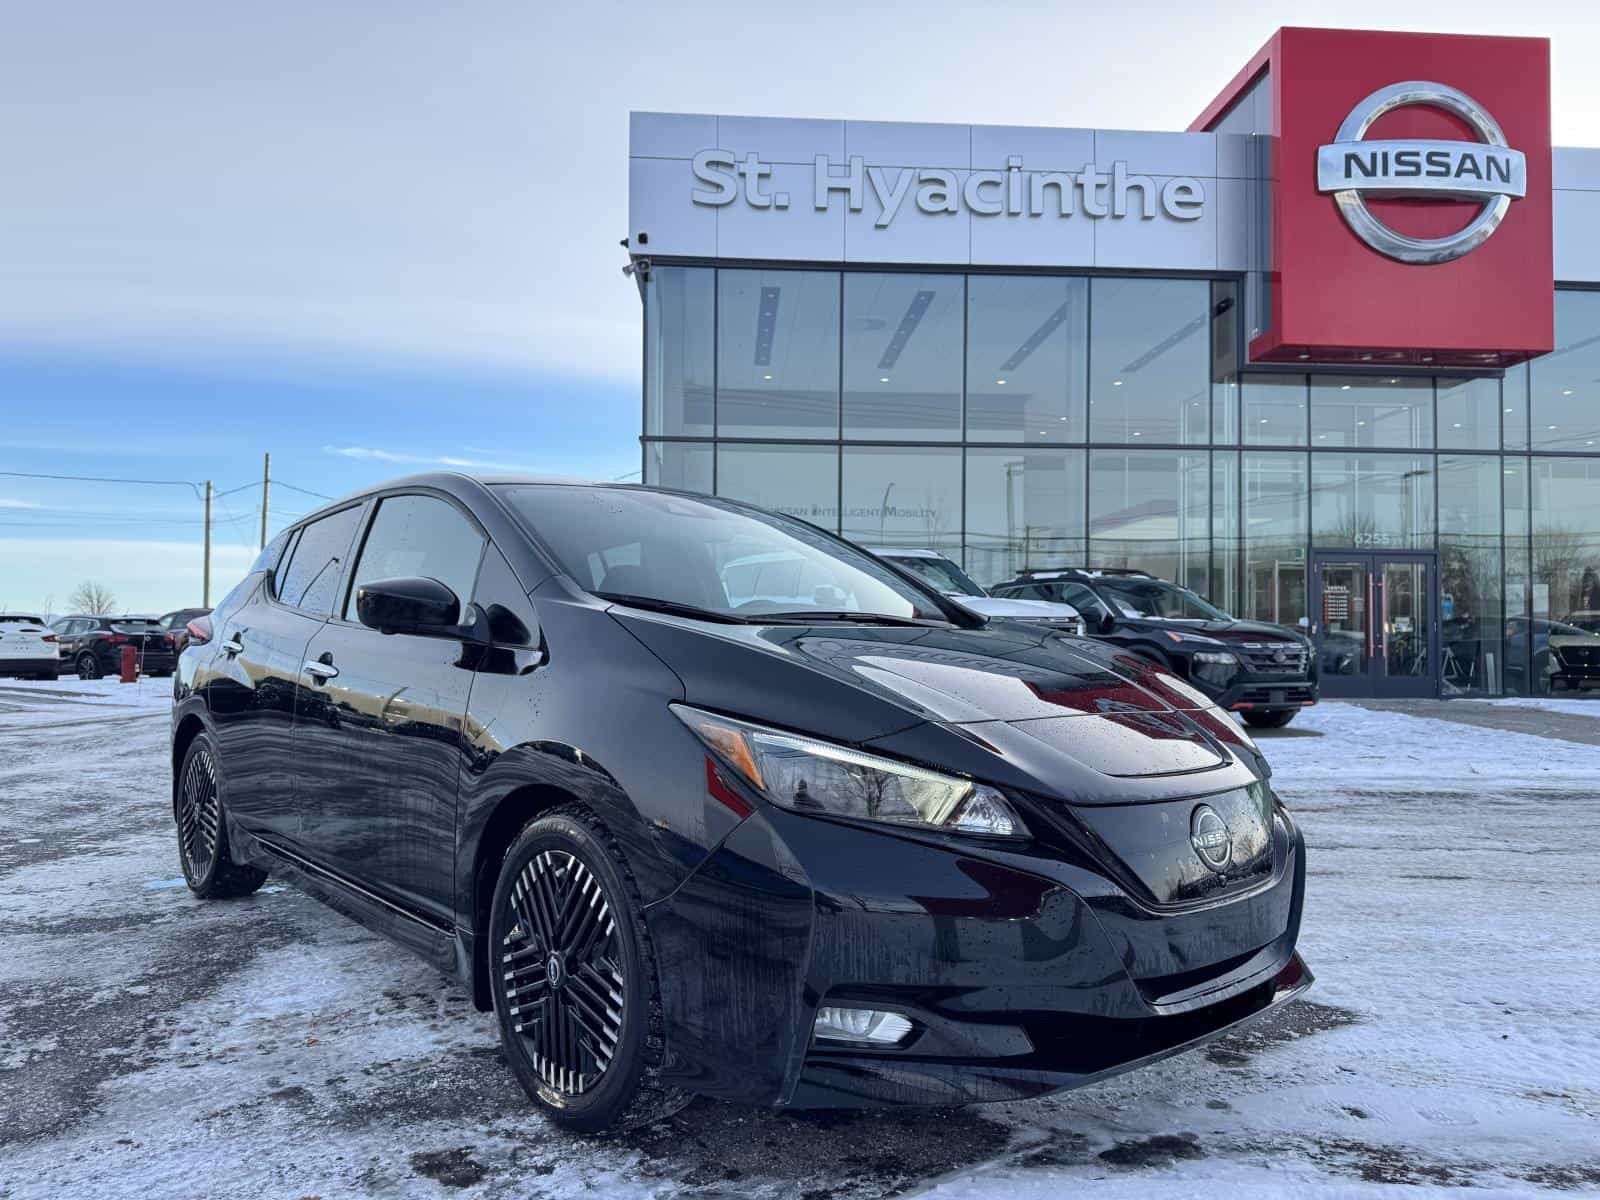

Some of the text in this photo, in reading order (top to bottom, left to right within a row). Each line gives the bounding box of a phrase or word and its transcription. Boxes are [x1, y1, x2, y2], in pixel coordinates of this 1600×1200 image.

[1343, 150, 1512, 185] NISSAN
[691, 147, 1206, 229] St. Hyacinthe
[811, 505, 880, 517] INTELIGENT
